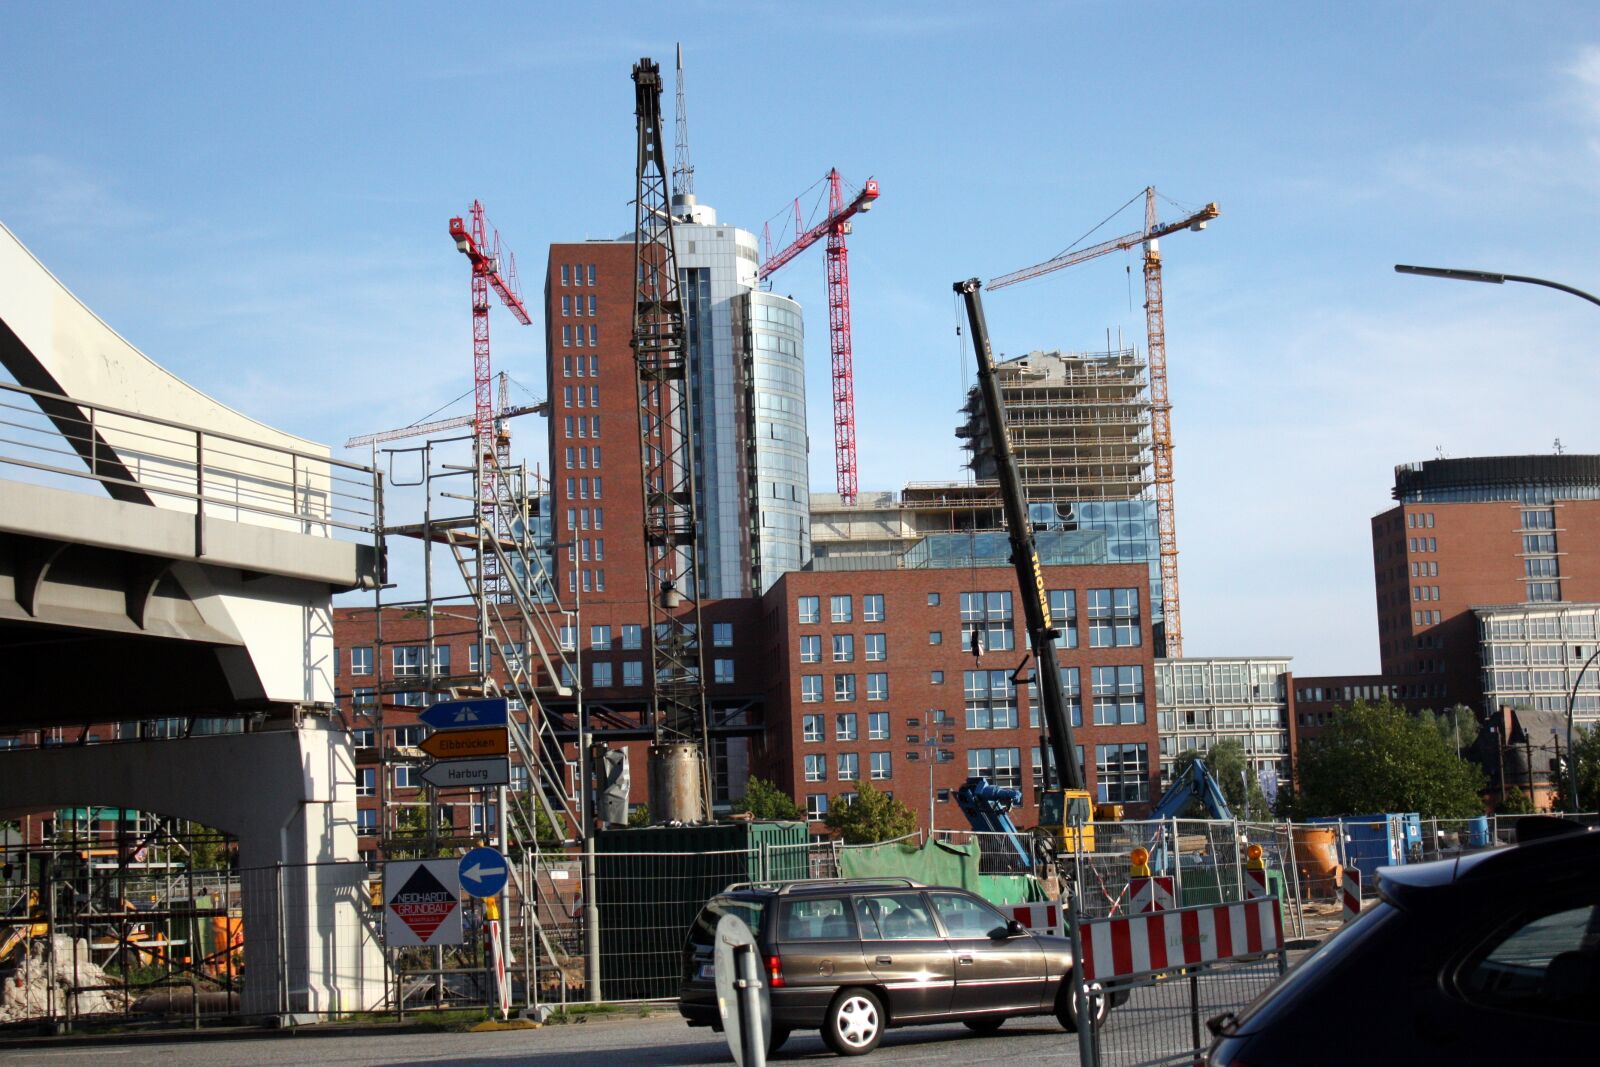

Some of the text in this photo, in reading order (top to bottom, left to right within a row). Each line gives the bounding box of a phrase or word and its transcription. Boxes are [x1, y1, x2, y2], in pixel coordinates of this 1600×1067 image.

[1032, 552, 1052, 629] THOMEN
[440, 738, 495, 750] Elbbrücken
[448, 768, 488, 779] Harburg
[398, 903, 448, 915] GRUNDBAU
